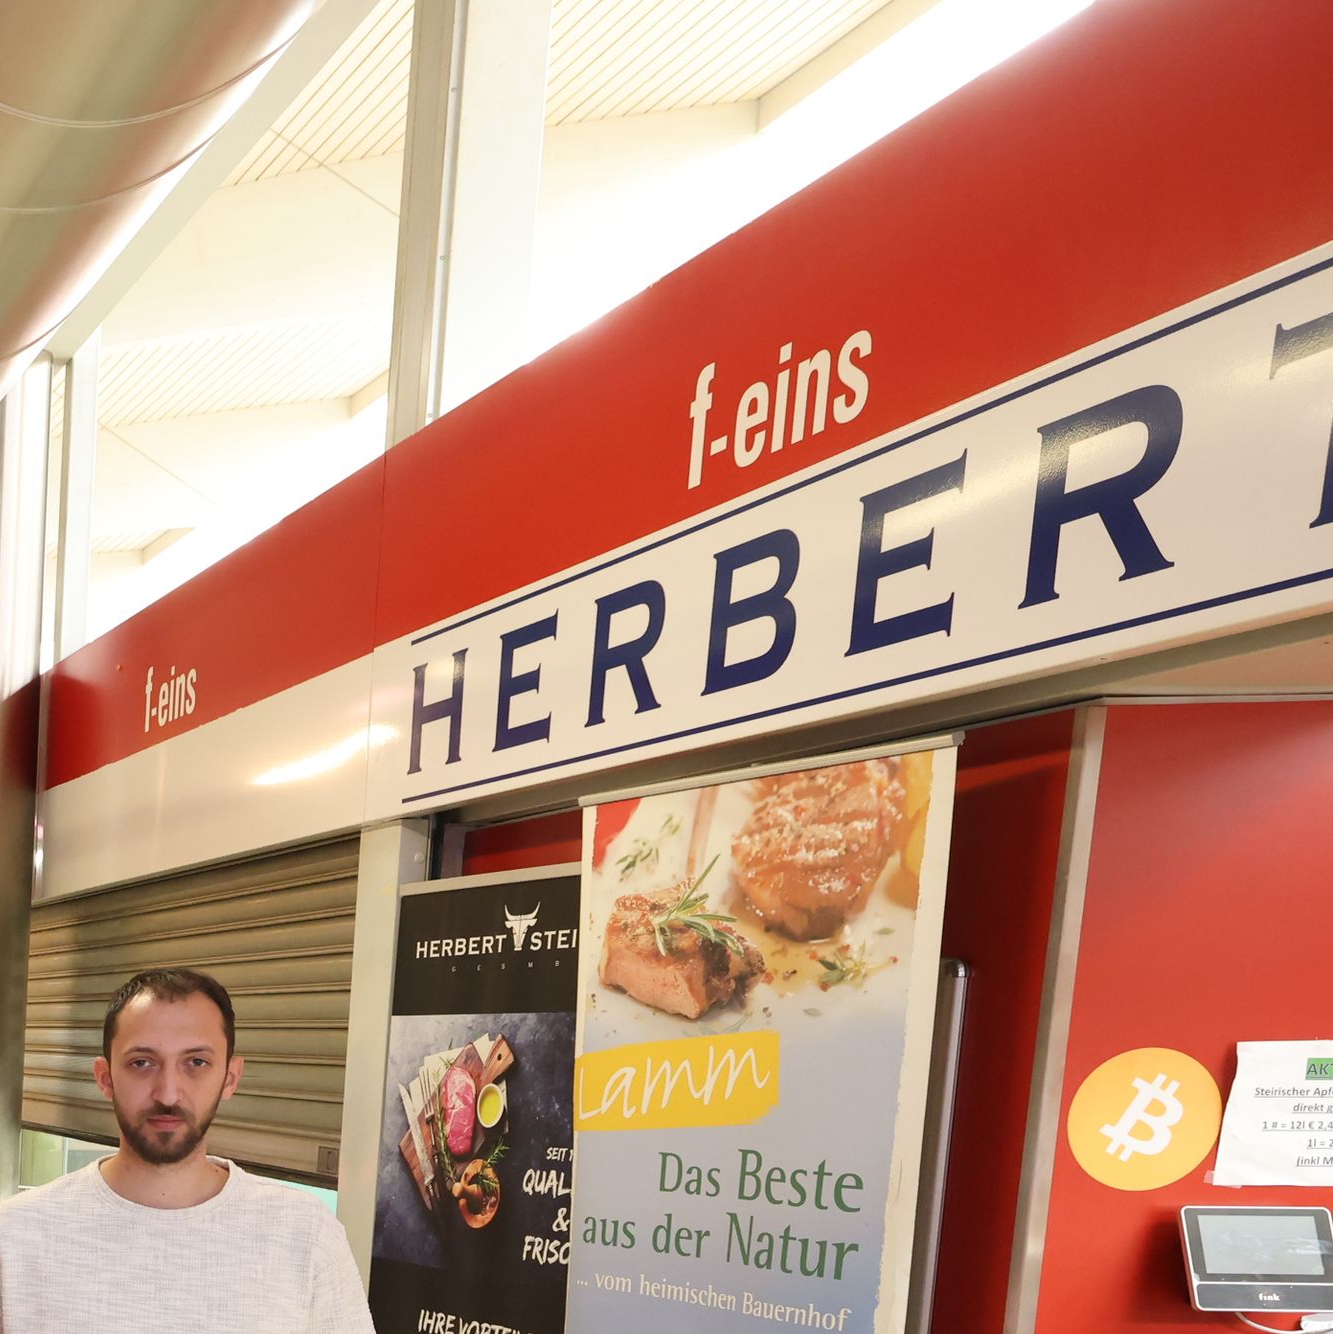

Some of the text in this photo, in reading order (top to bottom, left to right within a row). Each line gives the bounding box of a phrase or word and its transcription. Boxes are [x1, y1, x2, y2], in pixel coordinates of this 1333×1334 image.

[688, 330, 873, 489] f-eins
[144, 664, 197, 733] f-eins
[416, 935, 507, 959] HERBERT
[579, 1045, 770, 1120] Lamm
[1254, 1086, 1310, 1096] Steirischer
[1293, 1102, 1324, 1112] direkt
[1308, 1121, 1315, 1130] €
[546, 1147, 568, 1162] SEIT
[659, 1148, 864, 1213] Das Beste
[552, 1207, 571, 1232] &
[583, 1212, 859, 1281] aus der Natur
[595, 1273, 632, 1293] vom
[639, 1273, 736, 1312] heimischen
[742, 1291, 852, 1332] Bauernhof
